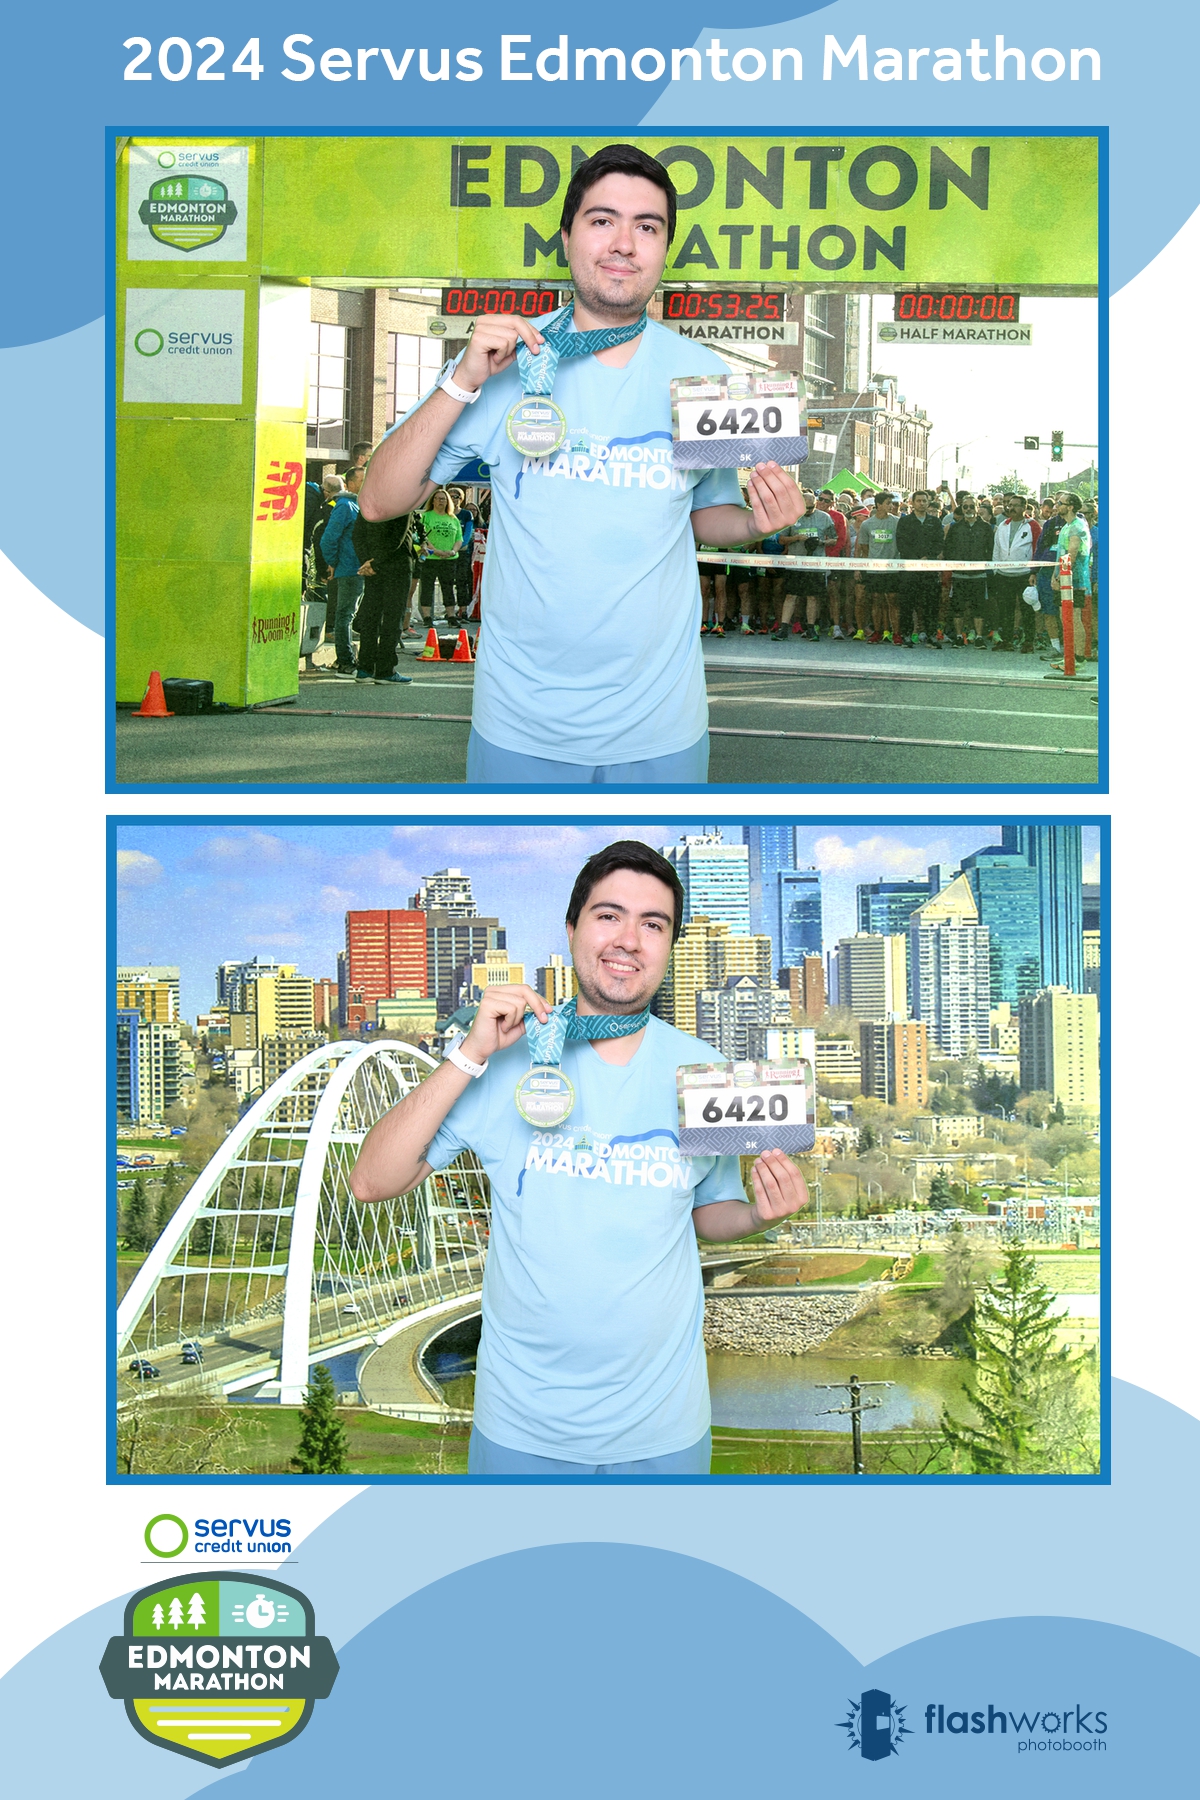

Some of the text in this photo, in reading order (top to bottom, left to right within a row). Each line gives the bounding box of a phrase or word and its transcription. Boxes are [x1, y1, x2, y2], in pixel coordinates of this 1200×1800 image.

[178, 152, 220, 161] servus
[149, 203, 227, 214] EDMONTON
[160, 214, 215, 222] MARATHON
[523, 224, 907, 271] MATHON
[168, 332, 233, 345] servus
[679, 325, 785, 340] MARATHON
[900, 328, 939, 340] HALF
[943, 328, 1031, 341] MARATHON
[168, 345, 233, 355] credit union
[696, 406, 782, 436] 6420
[590, 442, 674, 464] EDMONTO
[522, 453, 688, 491] MARATHON
[702, 1094, 788, 1123] 6420
[531, 1130, 575, 1151] 2024
[745, 1141, 758, 1149] 5K
[524, 1145, 692, 1190] MARATHON
